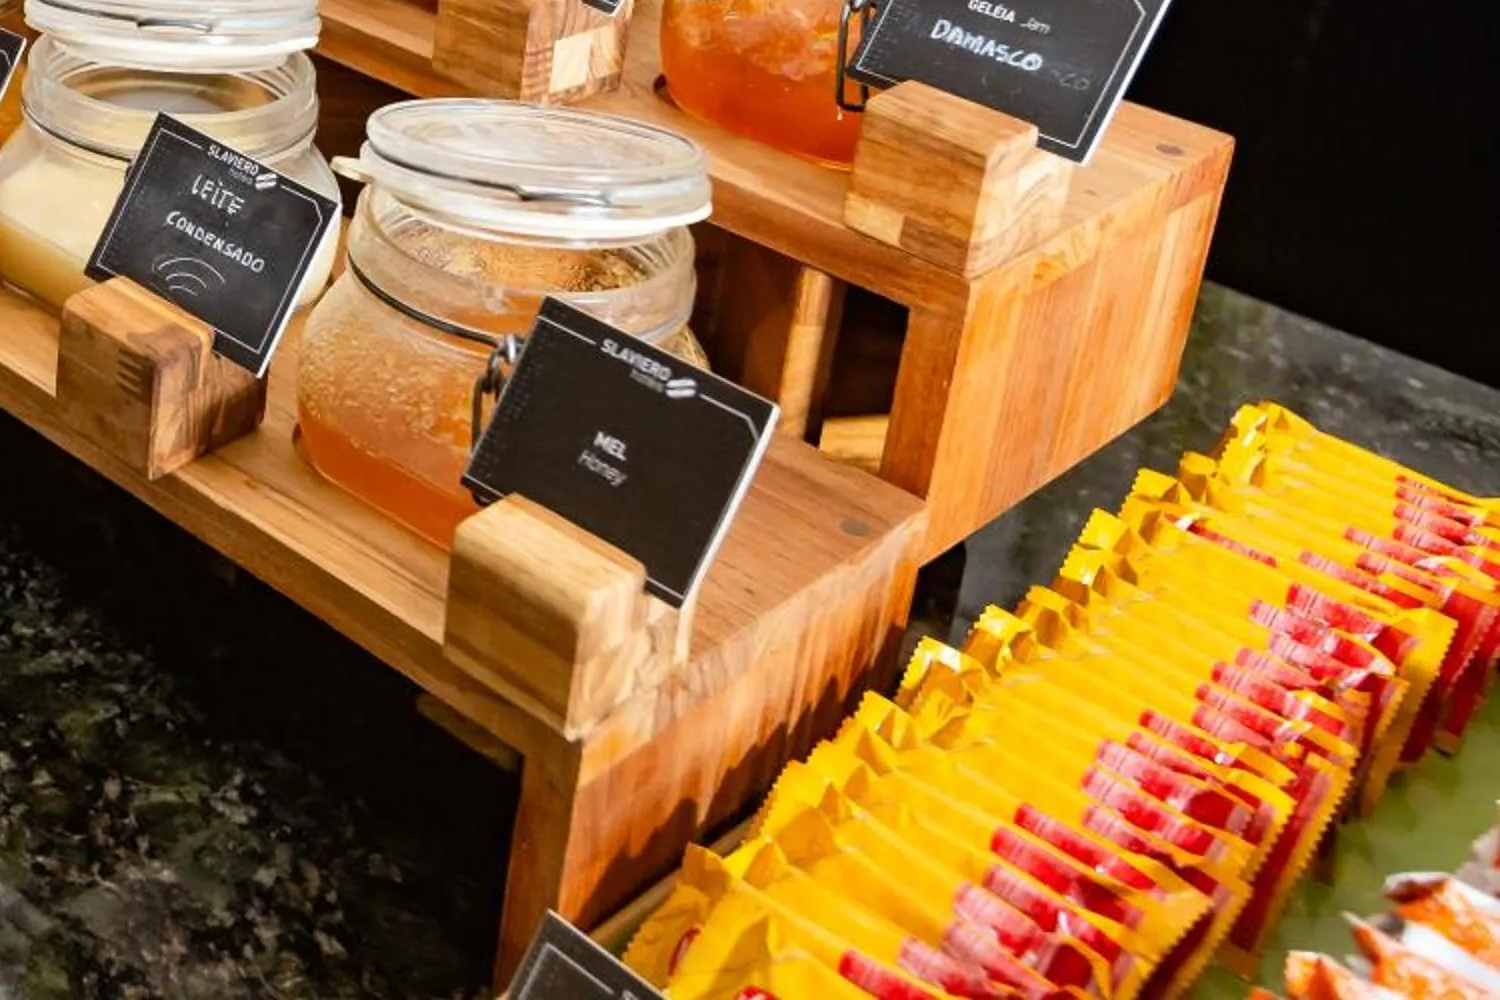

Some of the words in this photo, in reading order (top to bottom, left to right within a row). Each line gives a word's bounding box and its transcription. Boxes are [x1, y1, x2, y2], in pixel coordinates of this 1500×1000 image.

[929, 18, 1043, 72] DAMASCO
[207, 144, 260, 176] SLAVIERO
[165, 210, 265, 273] CONDENSADO
[600, 338, 672, 381] SLAVIERO
[593, 431, 628, 461] MEL
[577, 449, 628, 488] Honey
